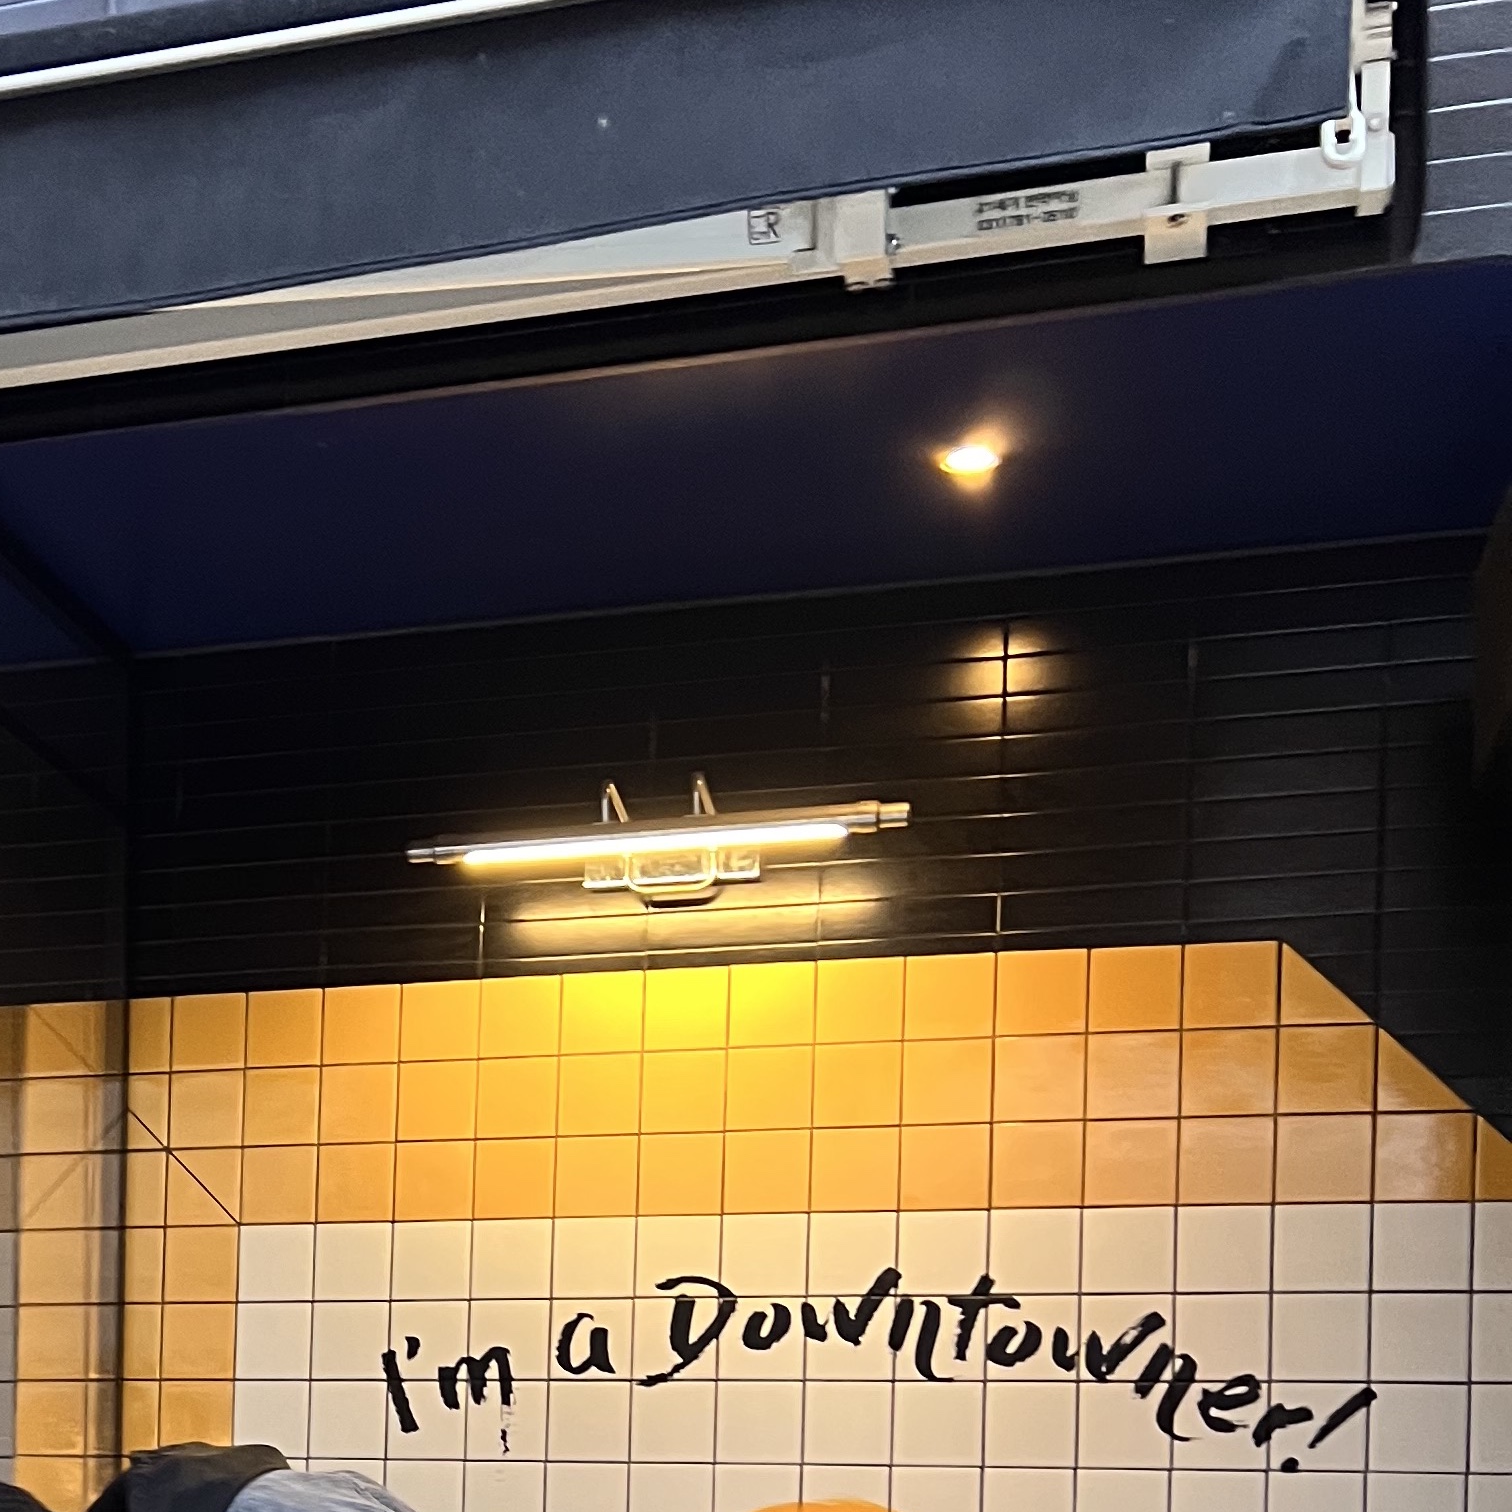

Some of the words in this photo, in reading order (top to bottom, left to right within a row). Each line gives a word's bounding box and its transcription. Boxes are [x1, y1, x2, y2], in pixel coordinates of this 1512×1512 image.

[381, 1335, 514, 1434] I'm
[555, 1312, 616, 1376] a
[634, 1267, 1380, 1474] Downtowner!
